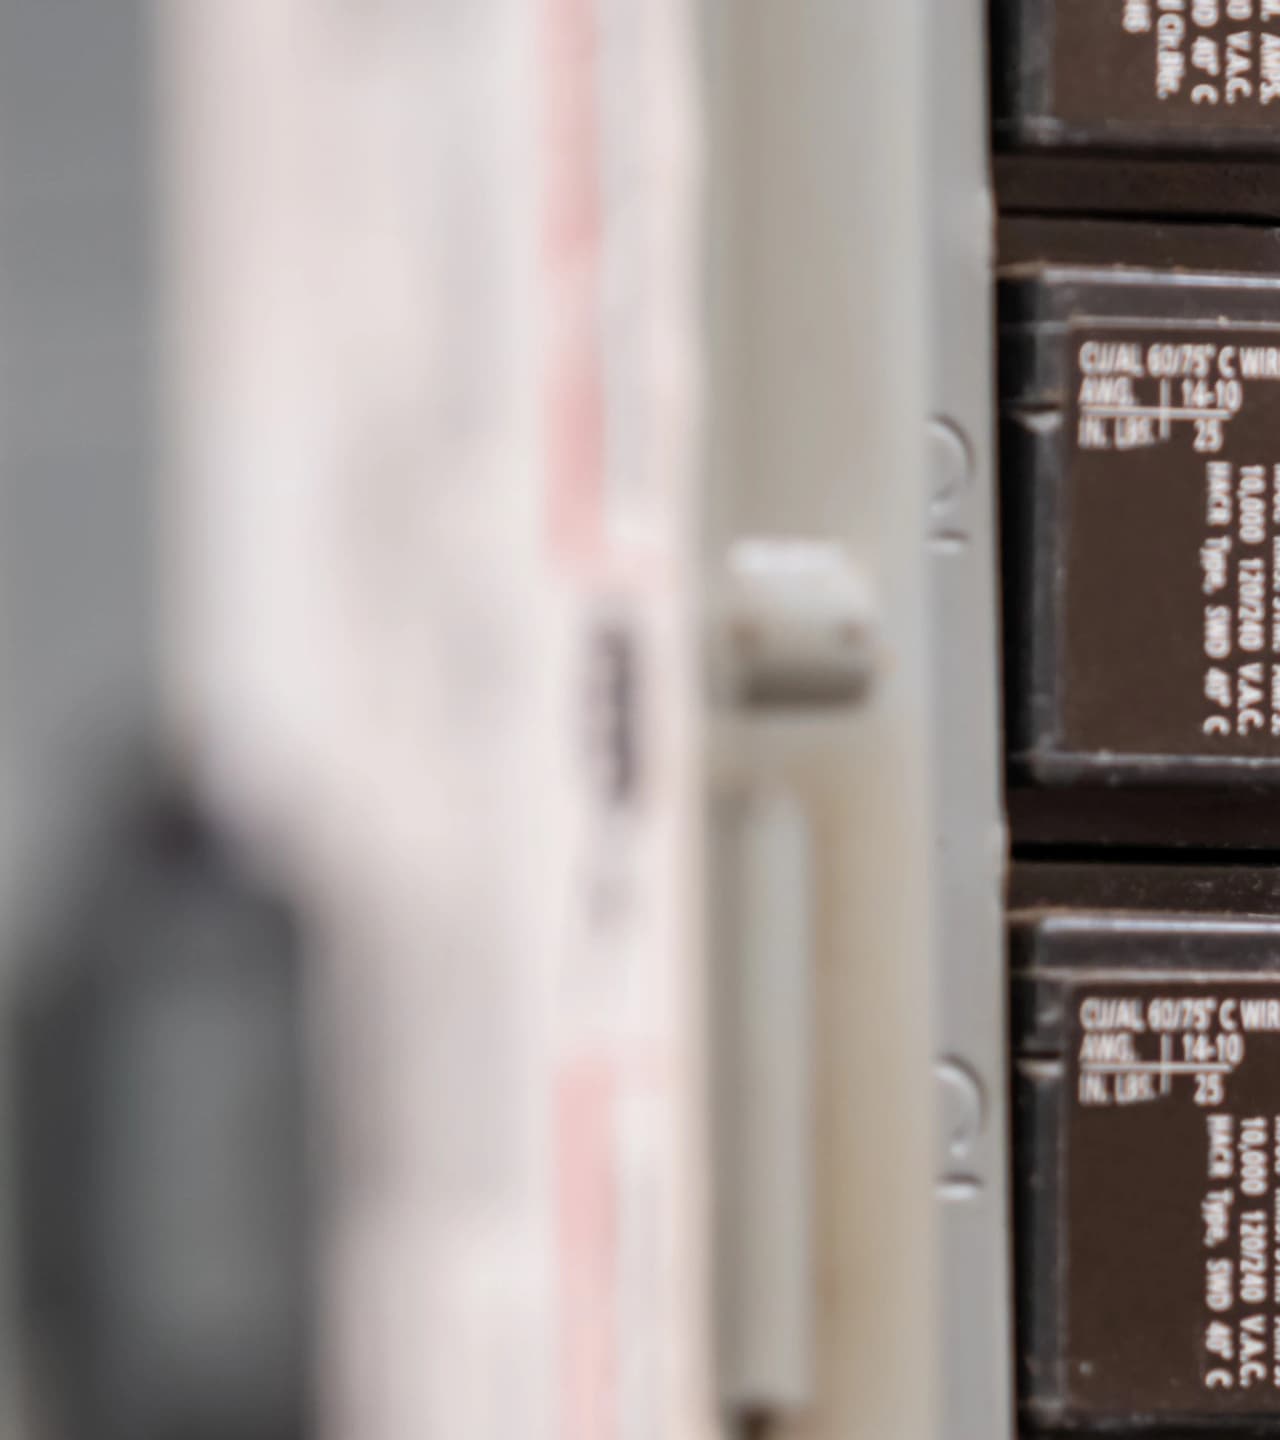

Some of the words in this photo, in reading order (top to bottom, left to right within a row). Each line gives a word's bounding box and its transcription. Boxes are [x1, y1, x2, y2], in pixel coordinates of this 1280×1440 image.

[1181, 378, 1242, 411] 14-10
[1193, 418, 1224, 451] 25
[1237, 465, 1265, 543] 10,000
[1238, 558, 1265, 650] 120/240
[1205, 606, 1230, 658] SWD
[1181, 1033, 1243, 1066] 14-10
[1194, 1073, 1223, 1105] 25
[1238, 1117, 1267, 1195] 10,000
[1240, 1211, 1266, 1302] 120/240
[1207, 1259, 1232, 1310] SWD
